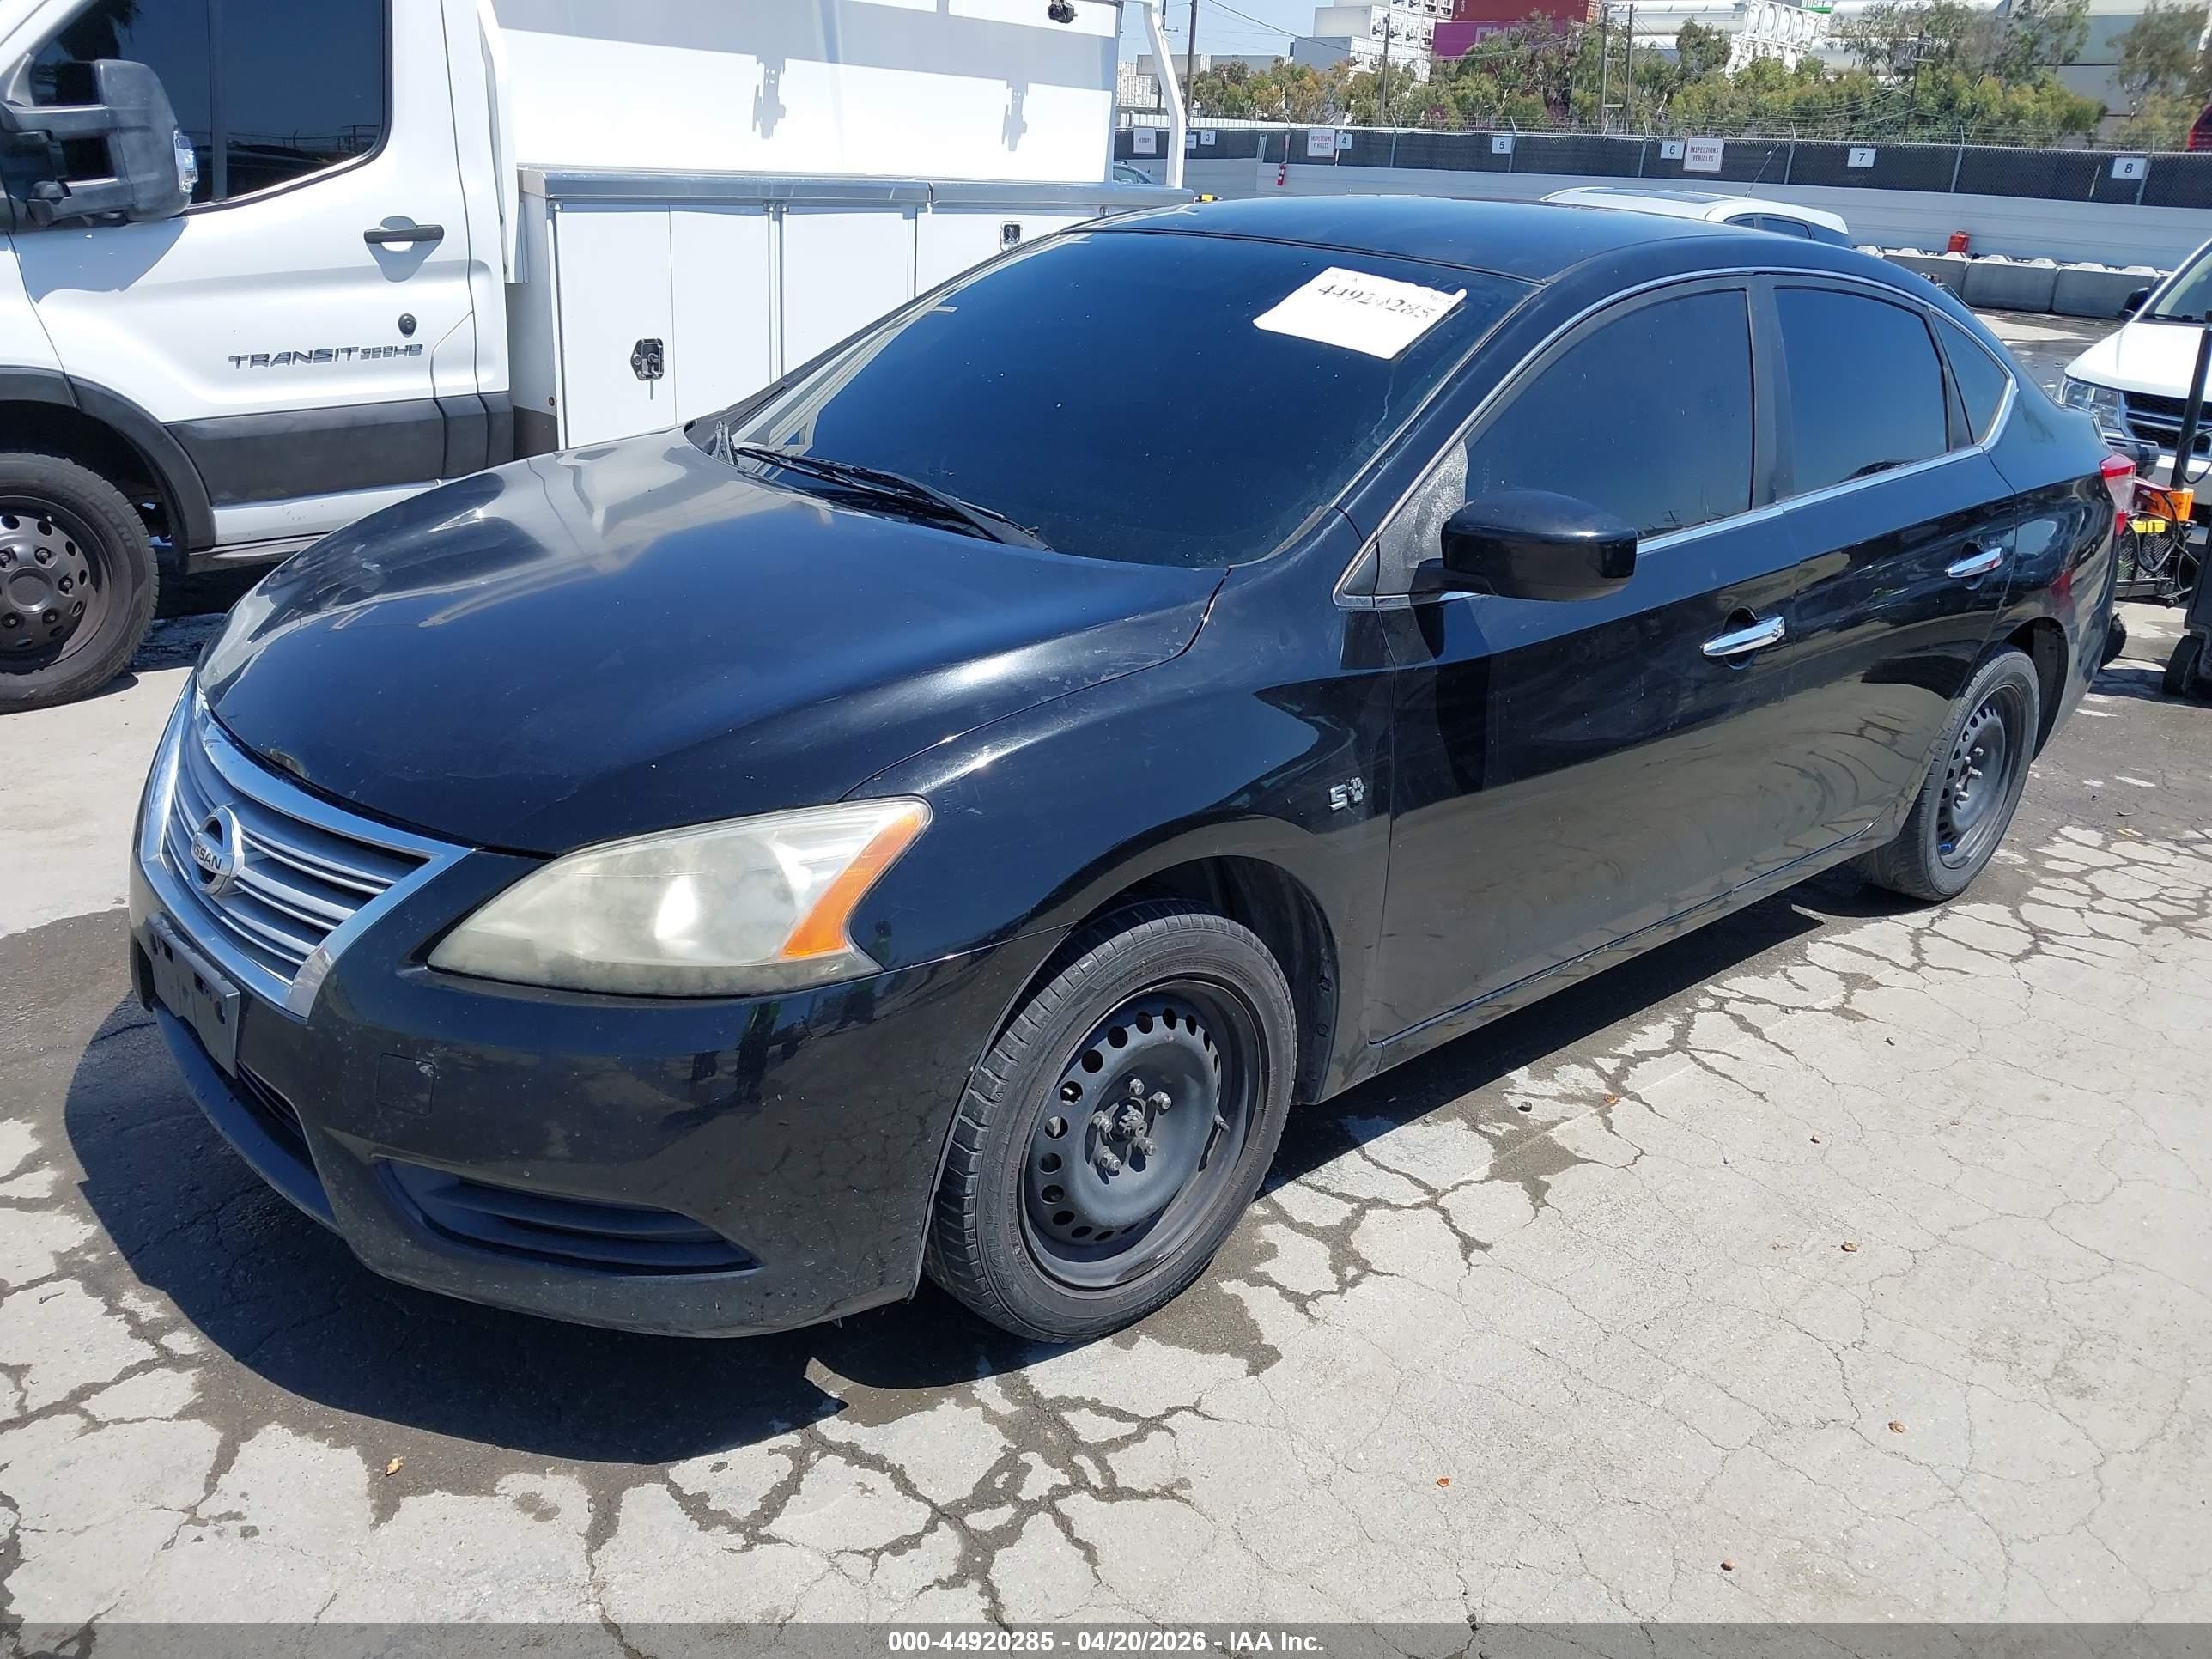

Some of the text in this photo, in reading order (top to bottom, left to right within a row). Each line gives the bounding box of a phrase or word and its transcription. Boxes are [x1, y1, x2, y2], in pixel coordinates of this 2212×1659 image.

[1499, 140, 1505, 149] 5
[1669, 144, 1676, 155] 6
[1690, 146, 1719, 155] INSPECTIONS
[1692, 154, 1714, 162] VEHICLES
[1859, 152, 1866, 162] 7
[2124, 162, 2134, 174] 8
[228, 347, 359, 370] TRANSIT
[194, 844, 222, 870] SSAN
